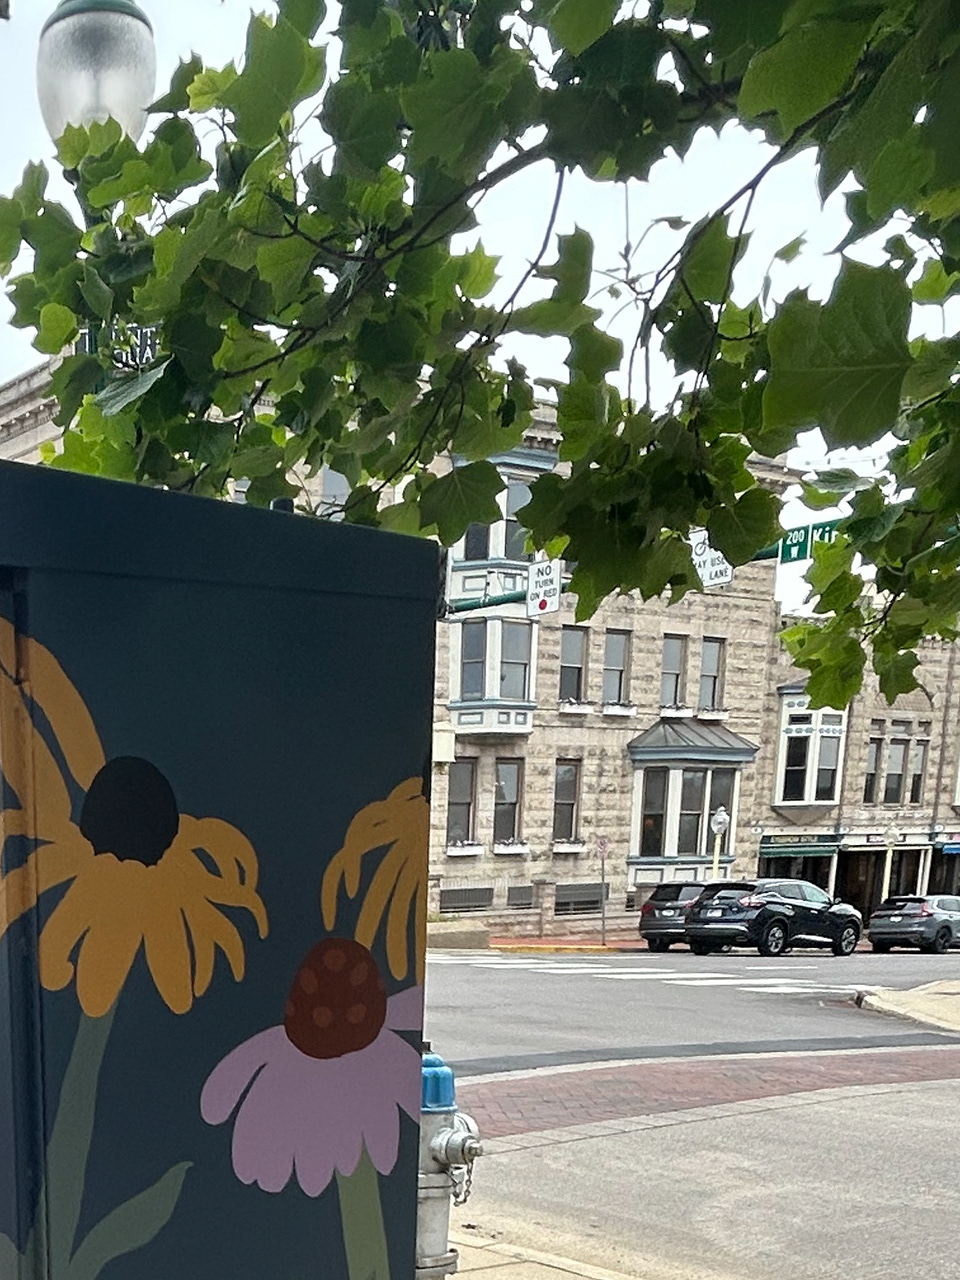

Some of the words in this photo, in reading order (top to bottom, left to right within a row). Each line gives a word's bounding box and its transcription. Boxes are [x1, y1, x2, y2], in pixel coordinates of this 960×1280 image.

[786, 529, 805, 545] 200
[790, 546, 799, 558] W
[694, 560, 708, 569] AY
[536, 565, 552, 577] NO
[709, 566, 729, 580] LANE
[535, 577, 554, 589] TURN
[530, 591, 540, 601] ON
[543, 587, 557, 598] RED
